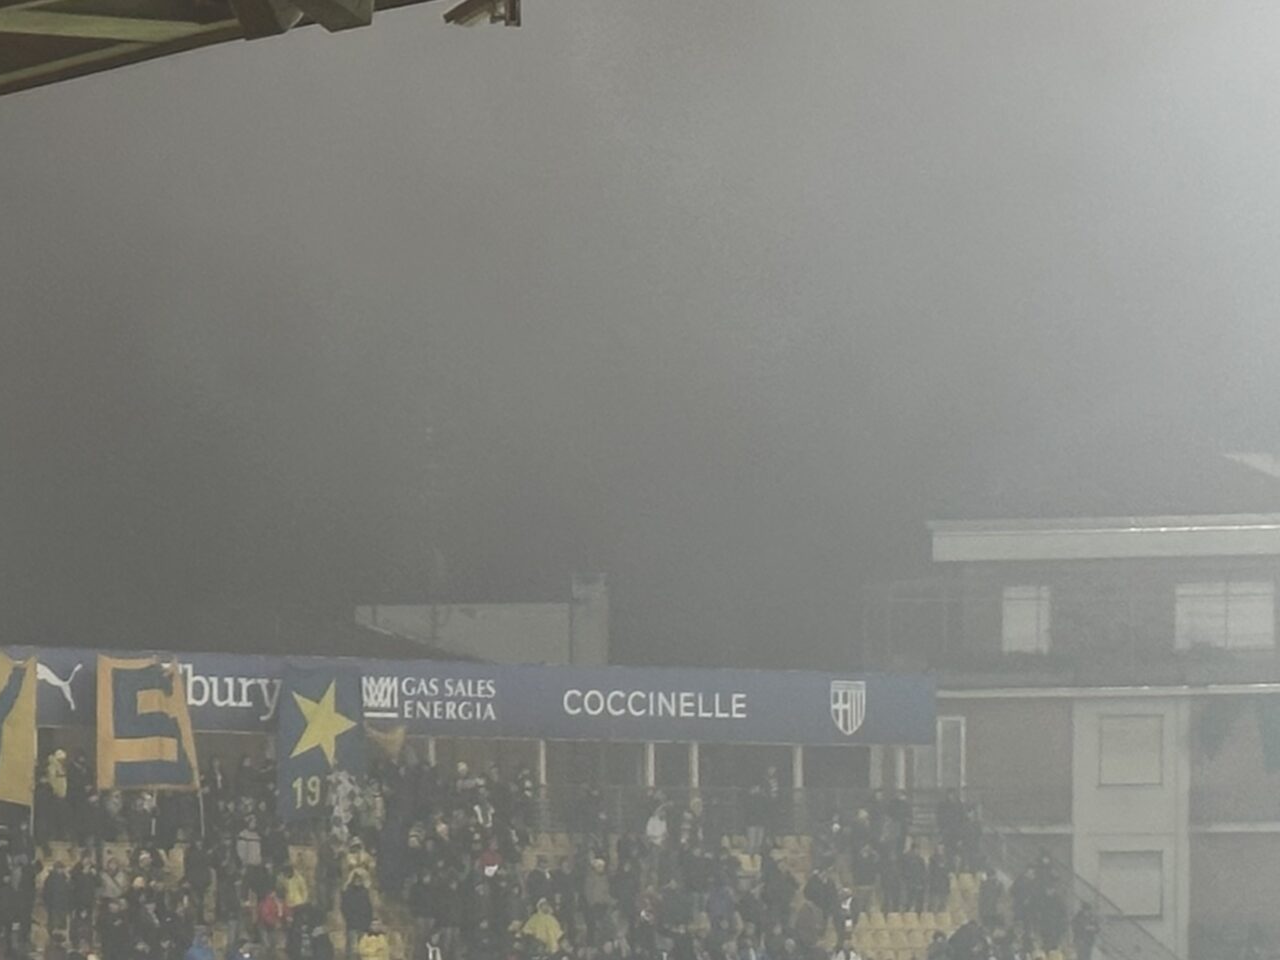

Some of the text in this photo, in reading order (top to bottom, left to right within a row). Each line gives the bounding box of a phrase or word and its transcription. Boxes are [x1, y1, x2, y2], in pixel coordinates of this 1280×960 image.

[401, 677, 496, 698] GAS SALES
[403, 701, 497, 721] ENERGIA
[562, 689, 748, 719] COCCINELLE
